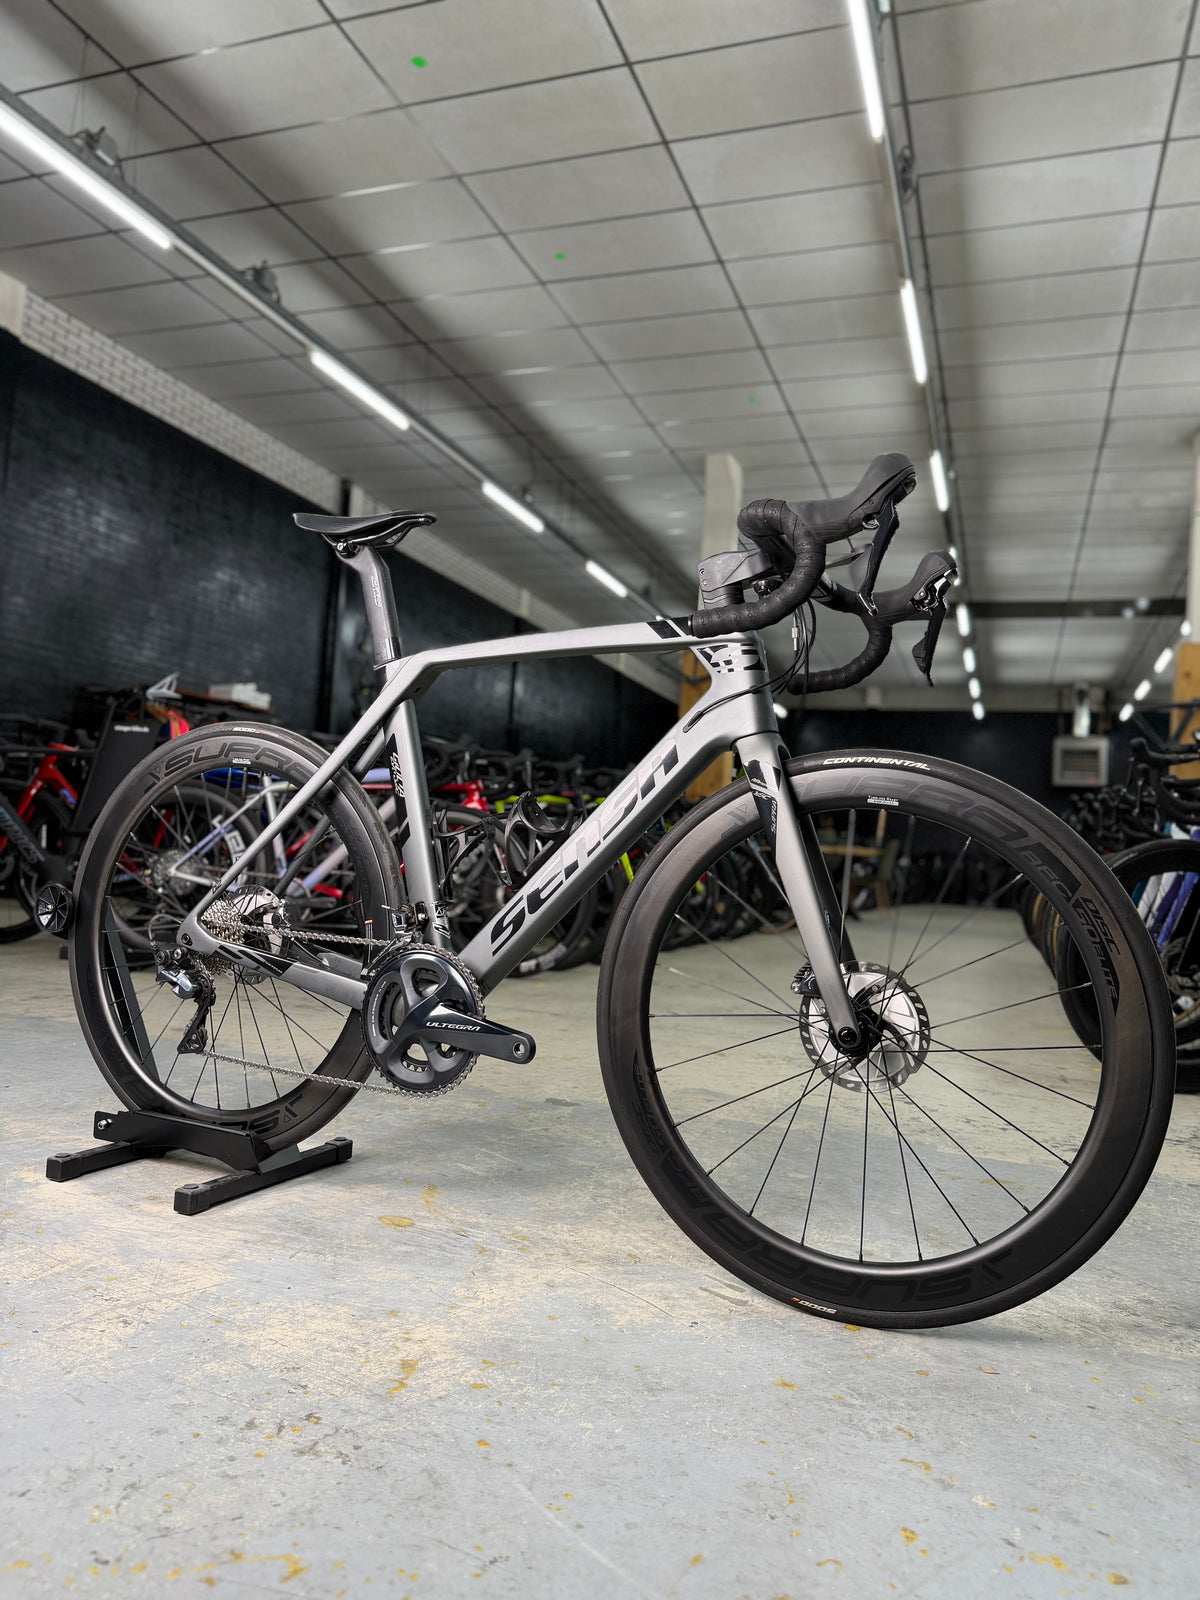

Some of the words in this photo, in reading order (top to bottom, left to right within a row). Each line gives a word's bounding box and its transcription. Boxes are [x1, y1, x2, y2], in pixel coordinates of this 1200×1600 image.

[822, 756, 931, 771] CONTINENTAL
[426, 1021, 481, 1032] ULTEGRA
[798, 1300, 838, 1315] 5000
